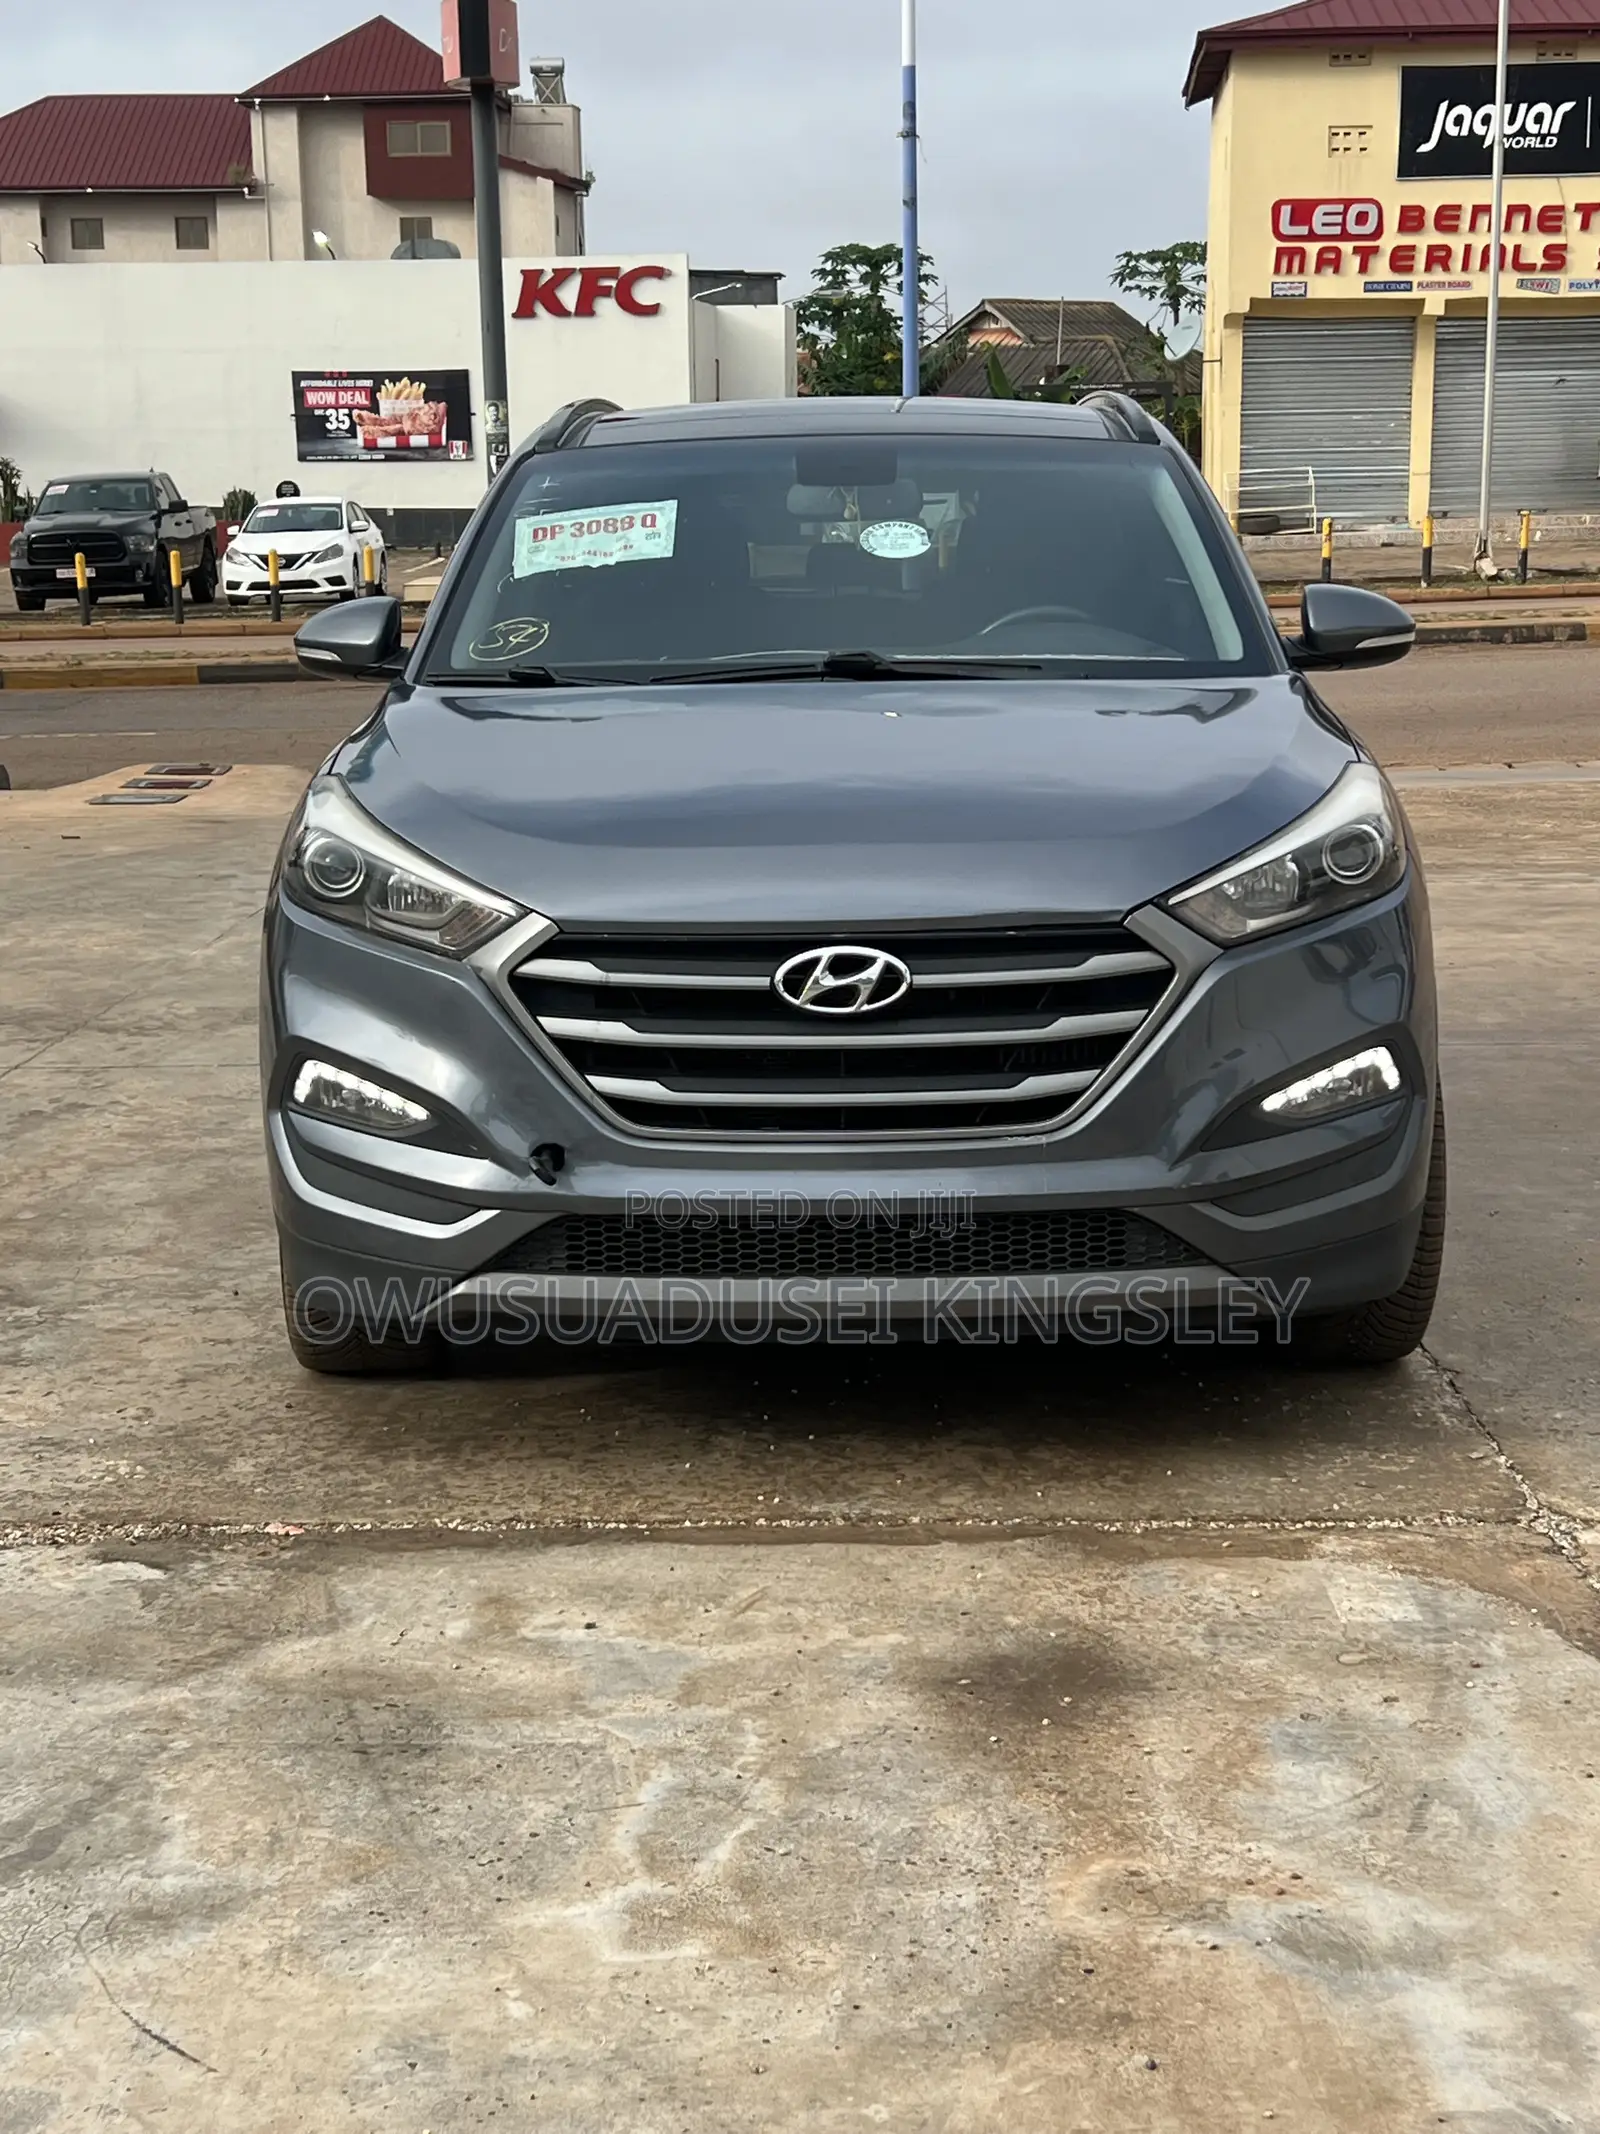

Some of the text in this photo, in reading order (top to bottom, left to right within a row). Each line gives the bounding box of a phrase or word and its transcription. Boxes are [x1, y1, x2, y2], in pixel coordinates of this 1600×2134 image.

[1279, 203, 1379, 236] LEO
[1273, 243, 1568, 275] MATERIALS
[511, 265, 668, 318] KFC
[306, 390, 369, 405] WOW DEAL
[325, 408, 350, 431] 35
